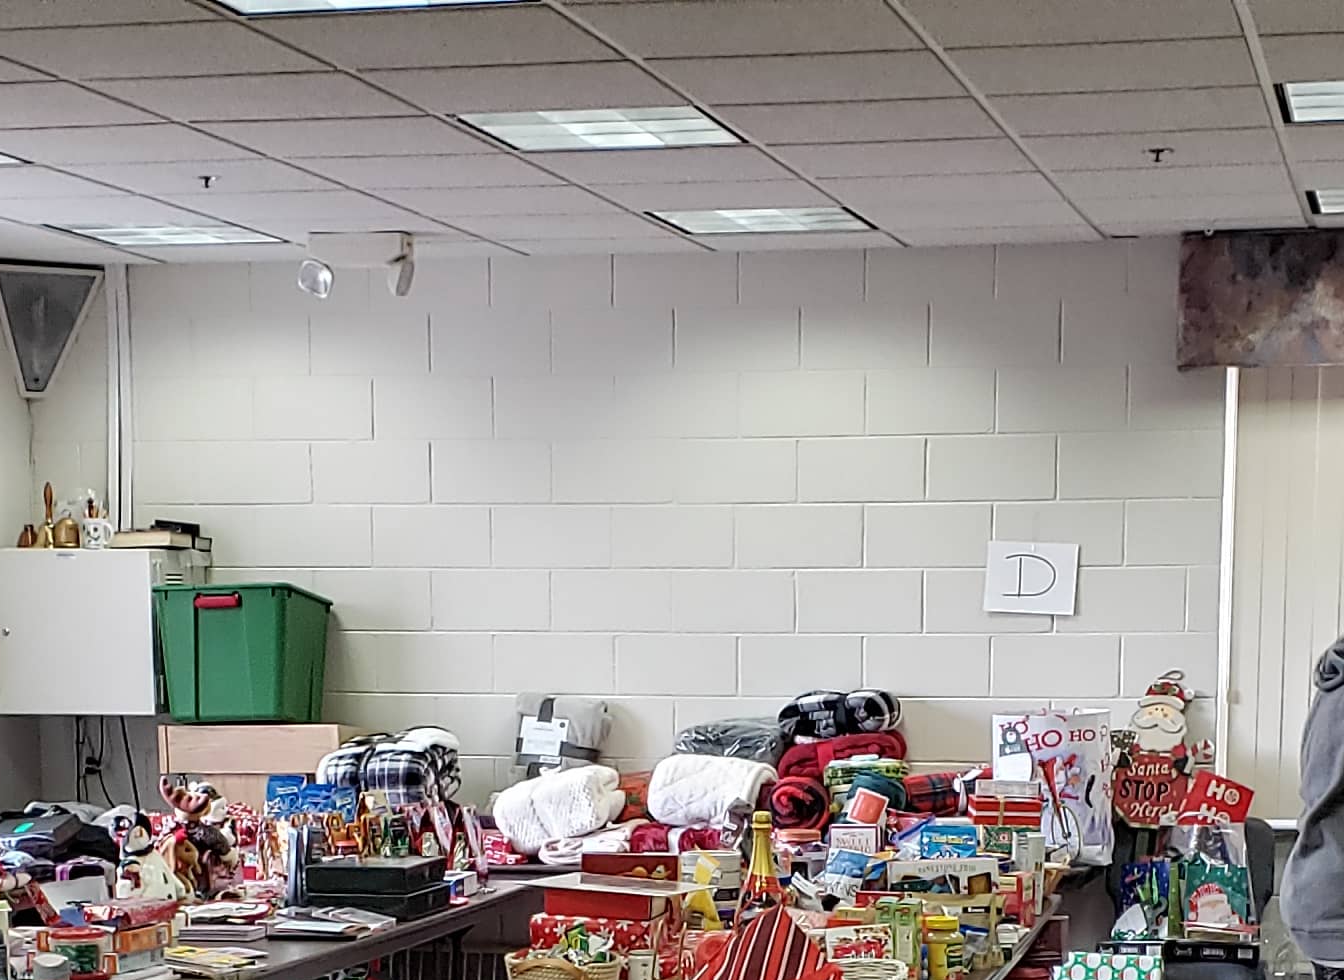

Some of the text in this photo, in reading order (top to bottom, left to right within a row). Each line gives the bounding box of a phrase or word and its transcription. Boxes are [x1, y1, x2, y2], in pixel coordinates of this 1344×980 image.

[1002, 553, 1056, 597] D
[1024, 729, 1096, 752] HO HO
[1127, 762, 1171, 777] Santa
[1120, 779, 1169, 802] STOP
